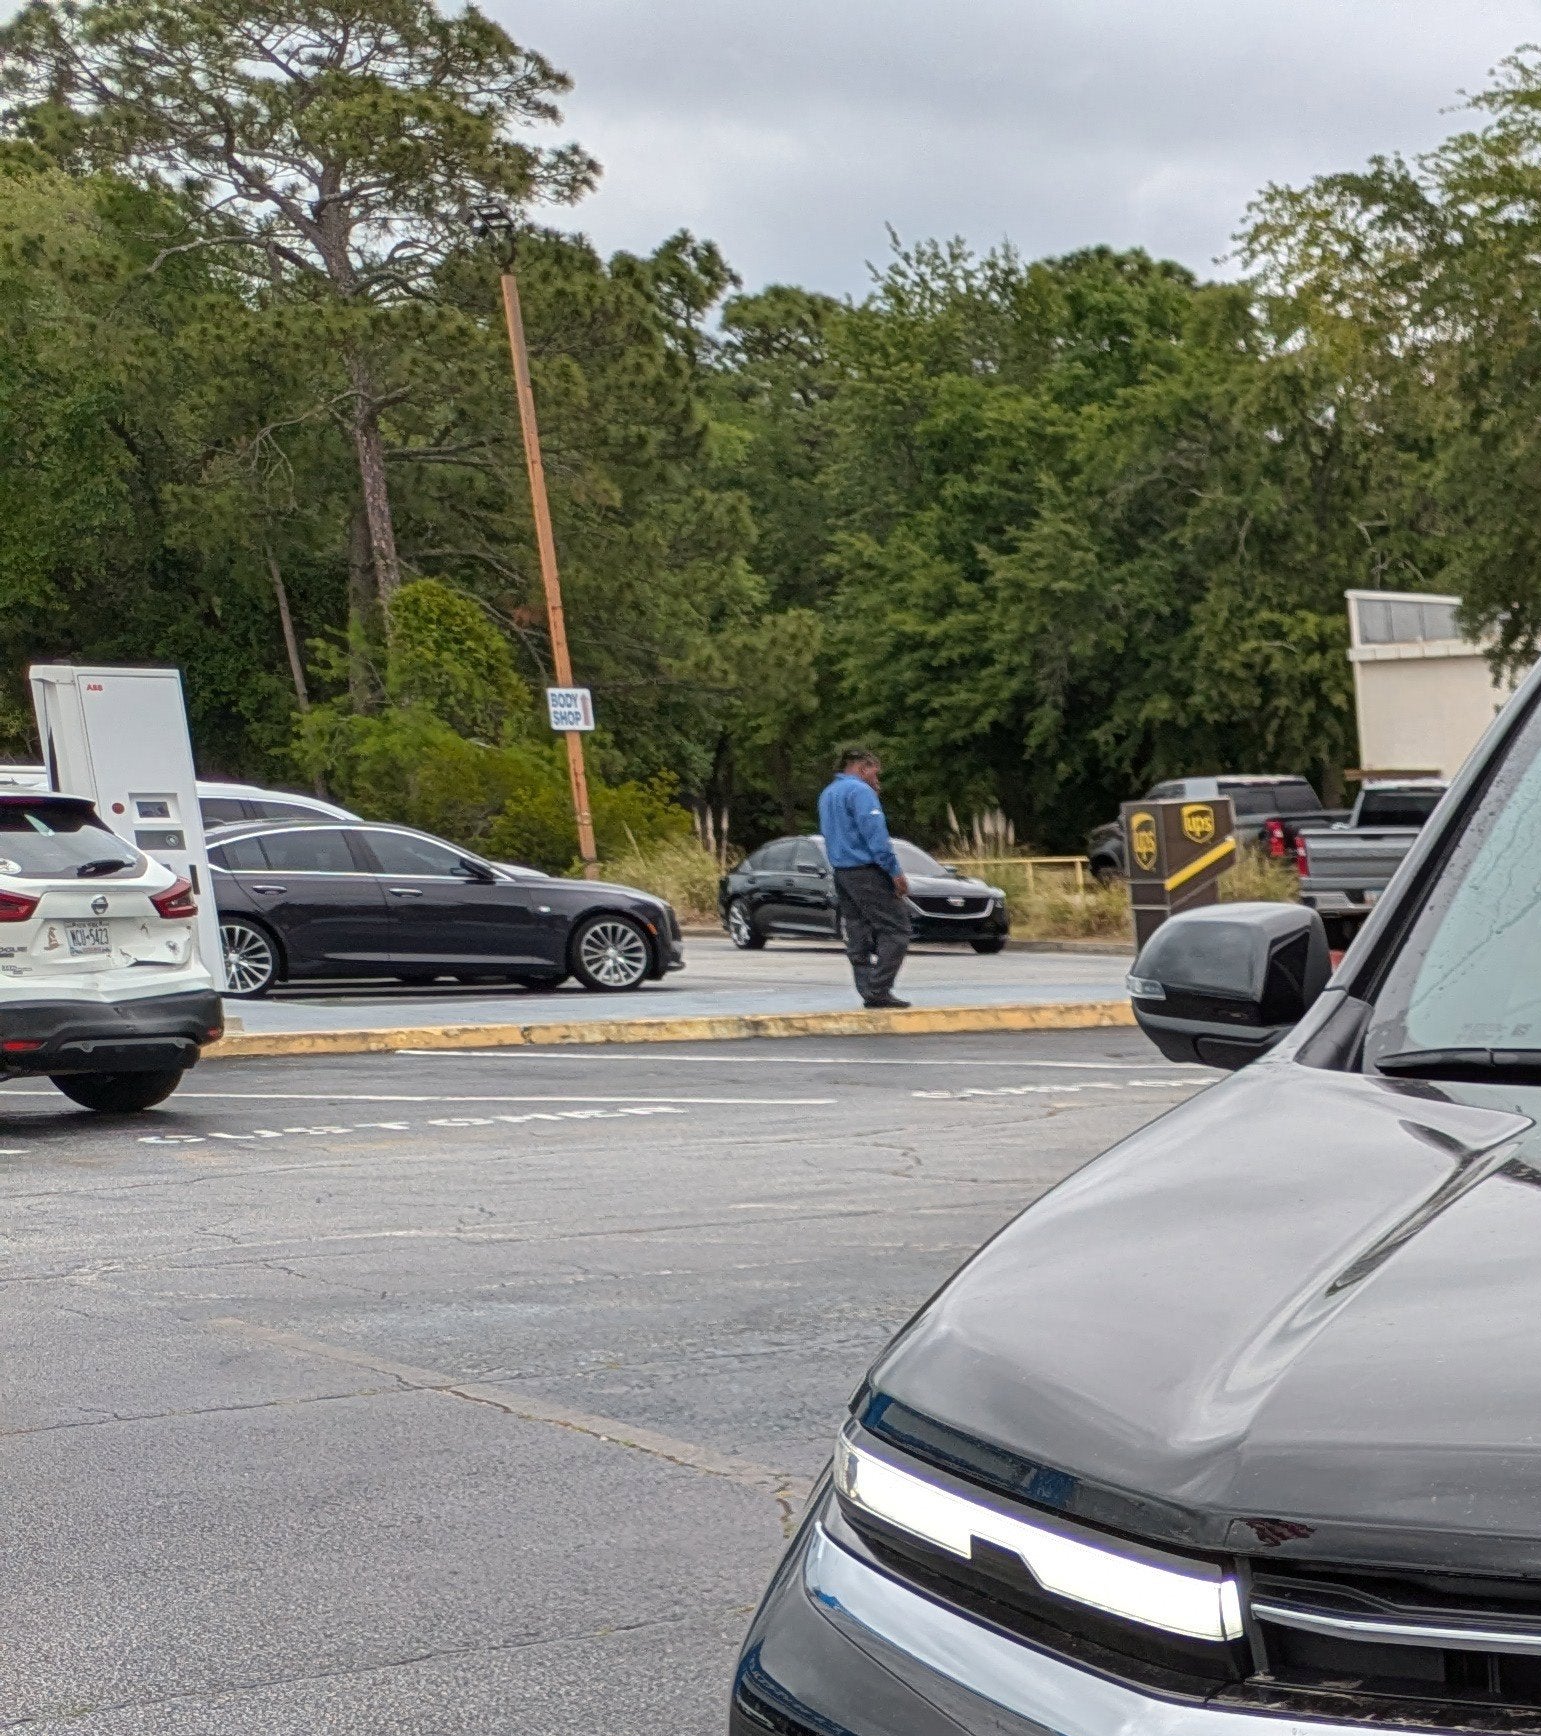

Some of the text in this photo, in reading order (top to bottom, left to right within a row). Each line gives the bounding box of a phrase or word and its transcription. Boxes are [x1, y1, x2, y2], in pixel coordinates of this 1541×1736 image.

[87, 683, 103, 691] ABB
[551, 693, 578, 708] BODY
[553, 710, 581, 726] SHOP
